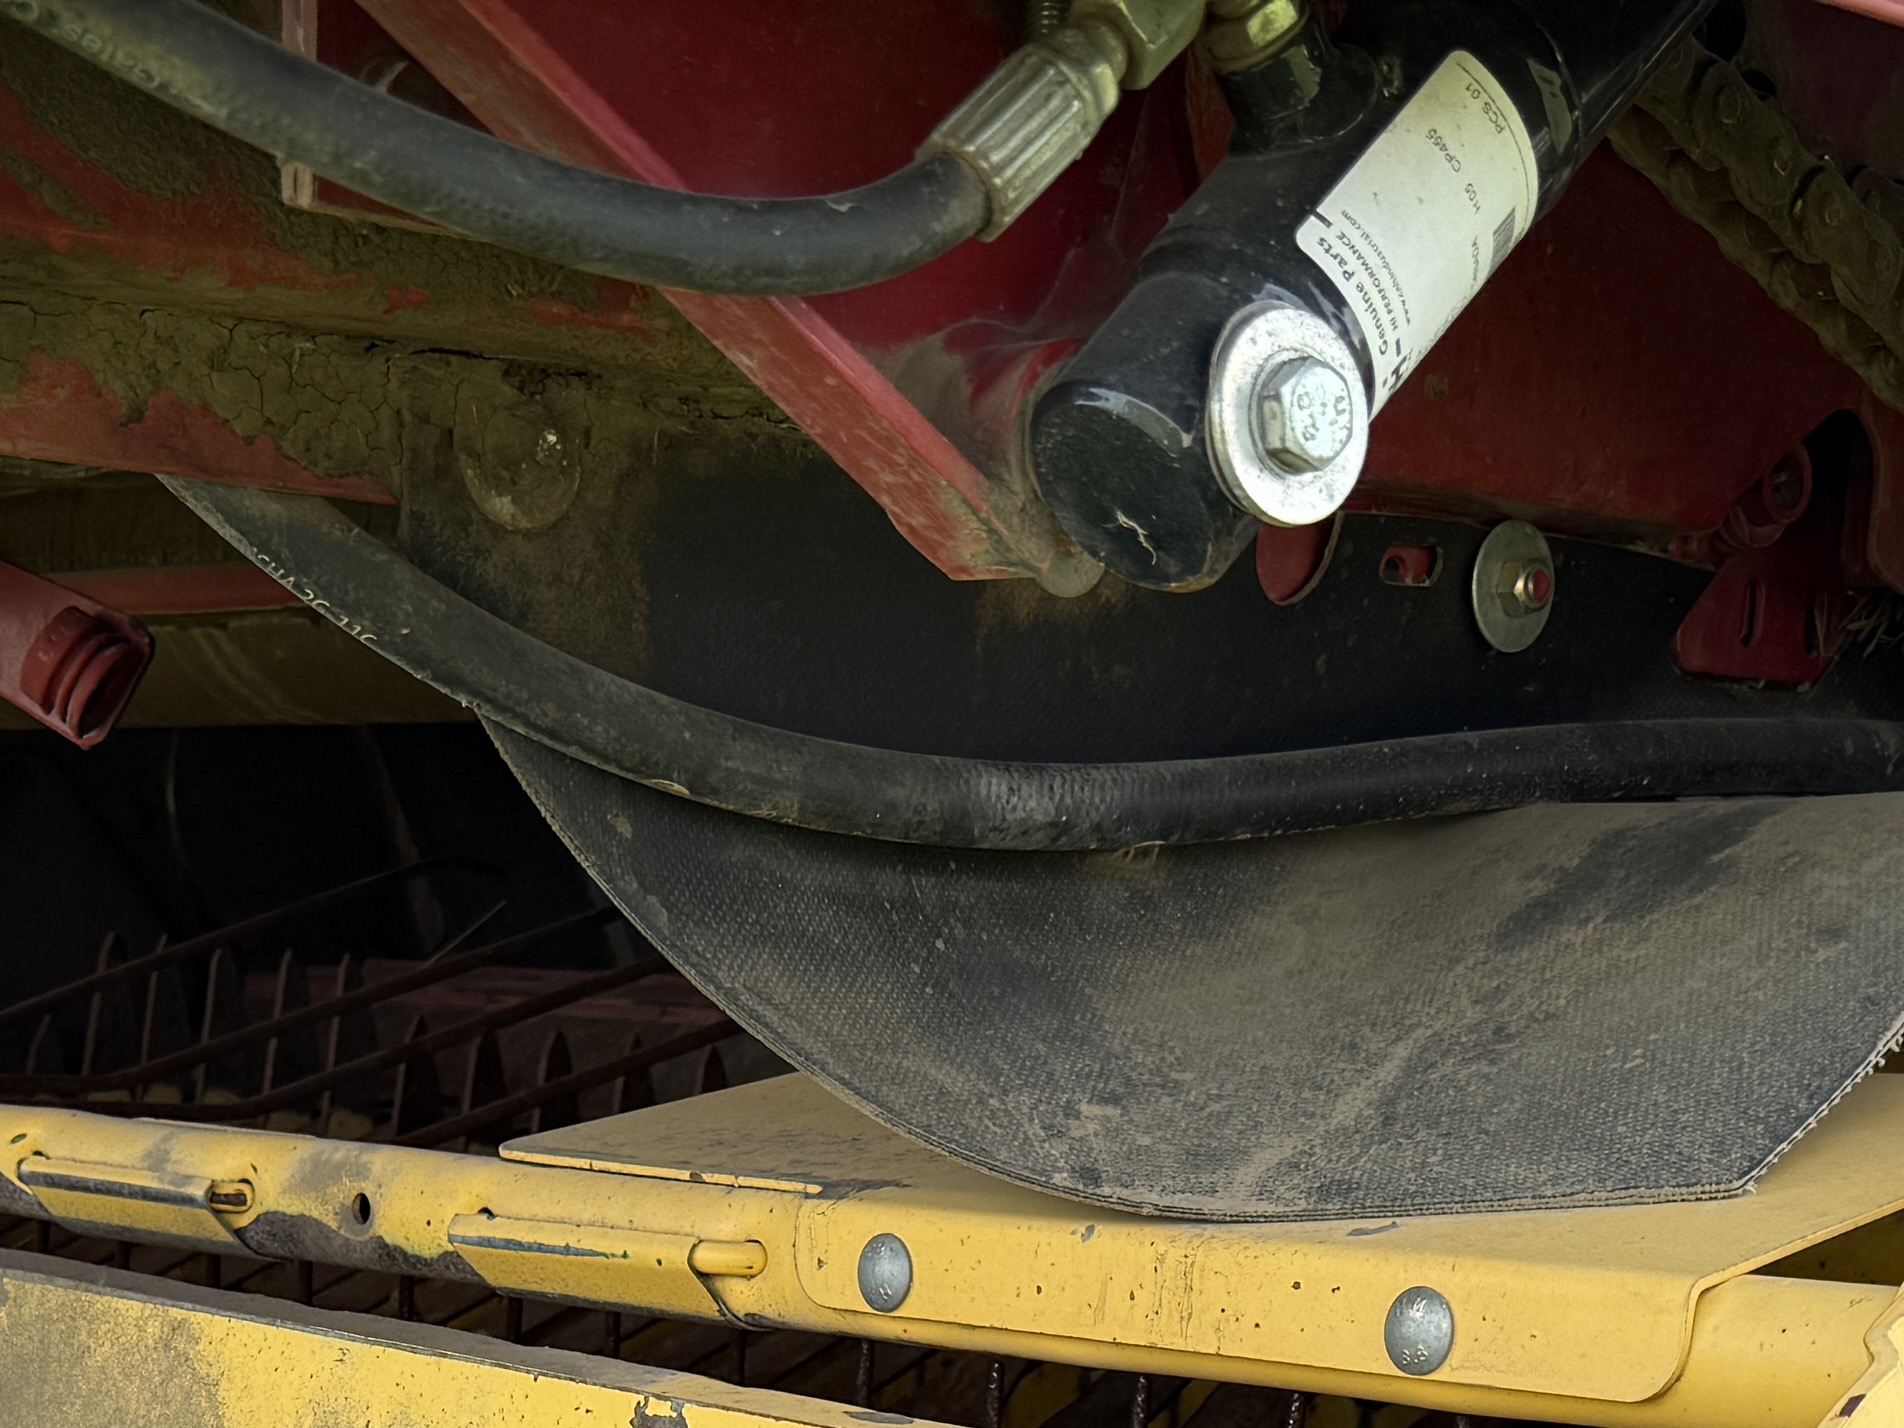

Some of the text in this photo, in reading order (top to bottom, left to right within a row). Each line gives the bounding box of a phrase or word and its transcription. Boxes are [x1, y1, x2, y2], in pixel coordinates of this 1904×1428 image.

[1316, 236, 1390, 357] Genuine Parts
[1335, 230, 1394, 316] PERFORMANCE
